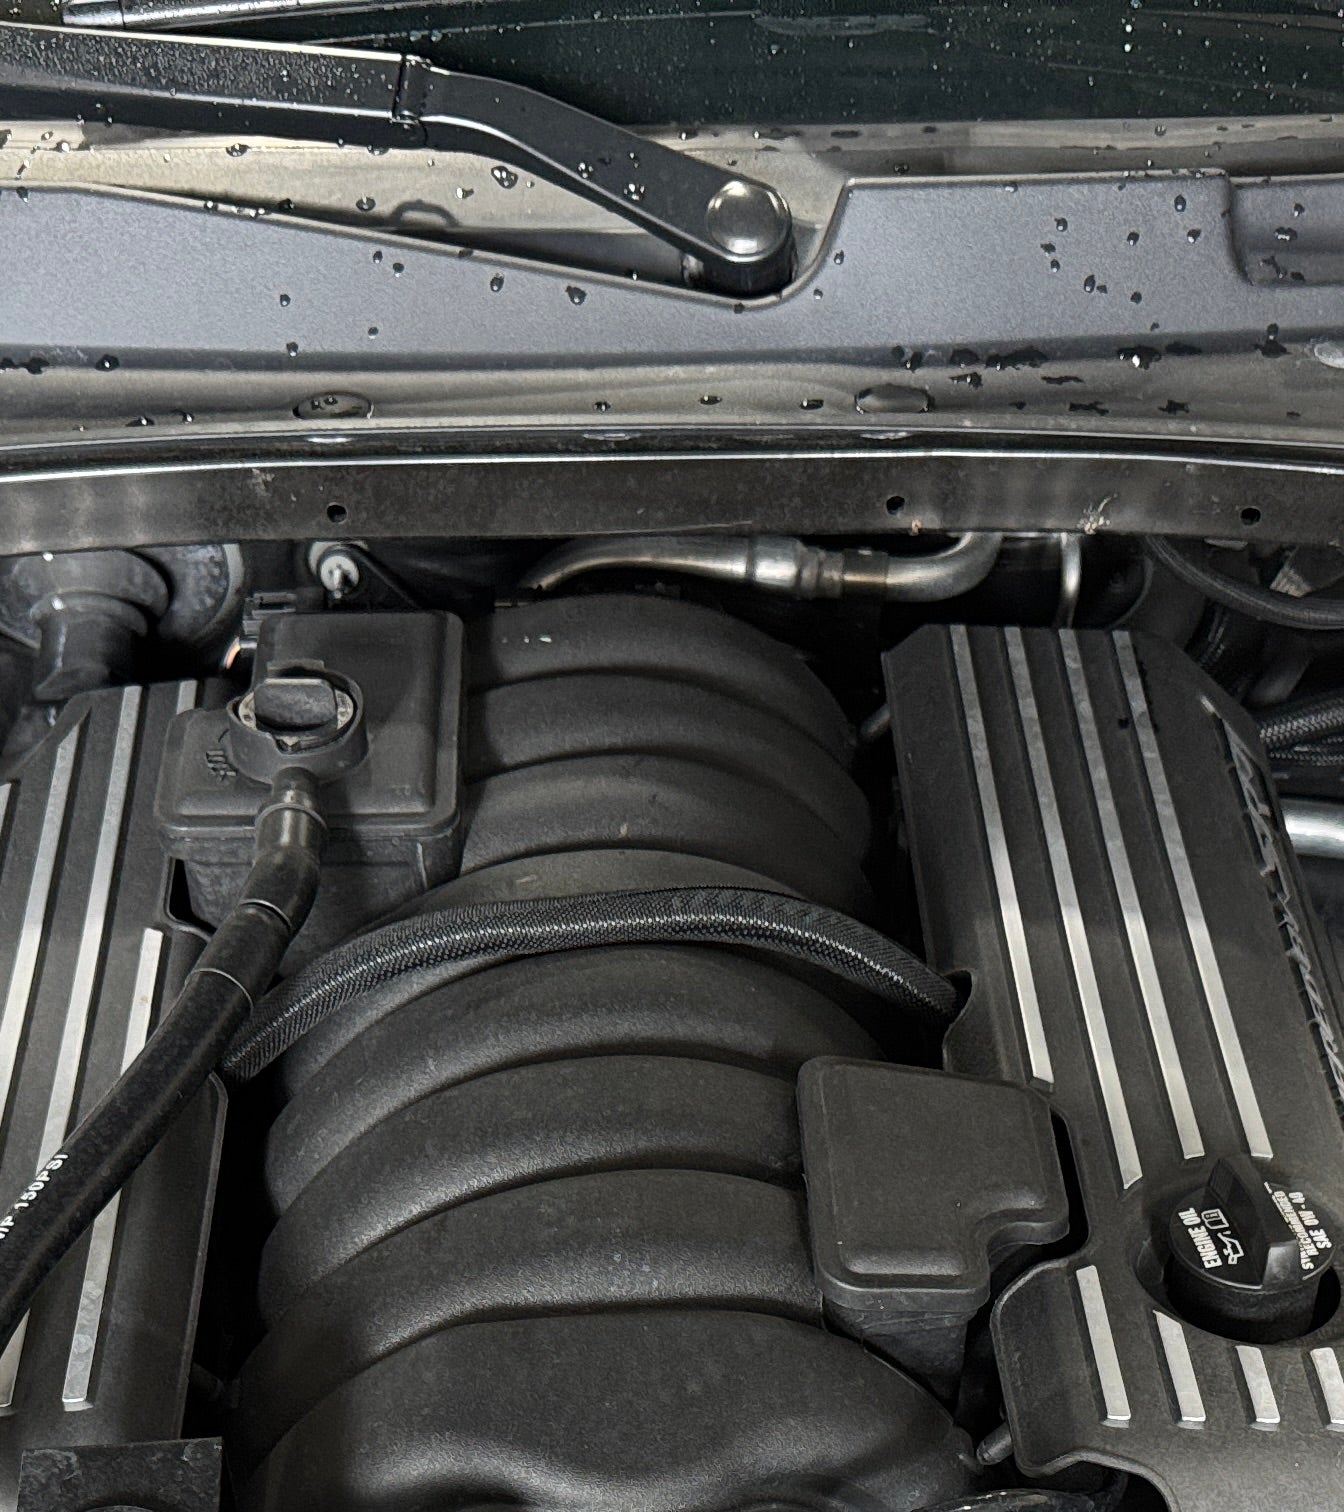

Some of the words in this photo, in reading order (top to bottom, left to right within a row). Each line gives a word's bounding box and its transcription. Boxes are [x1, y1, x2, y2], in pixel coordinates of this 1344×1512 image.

[14, 1154, 68, 1209] 150PSI
[1178, 1207, 1202, 1226] OIL
[1188, 1225, 1223, 1269] ENGINE
[1309, 1228, 1332, 1249] SAE
